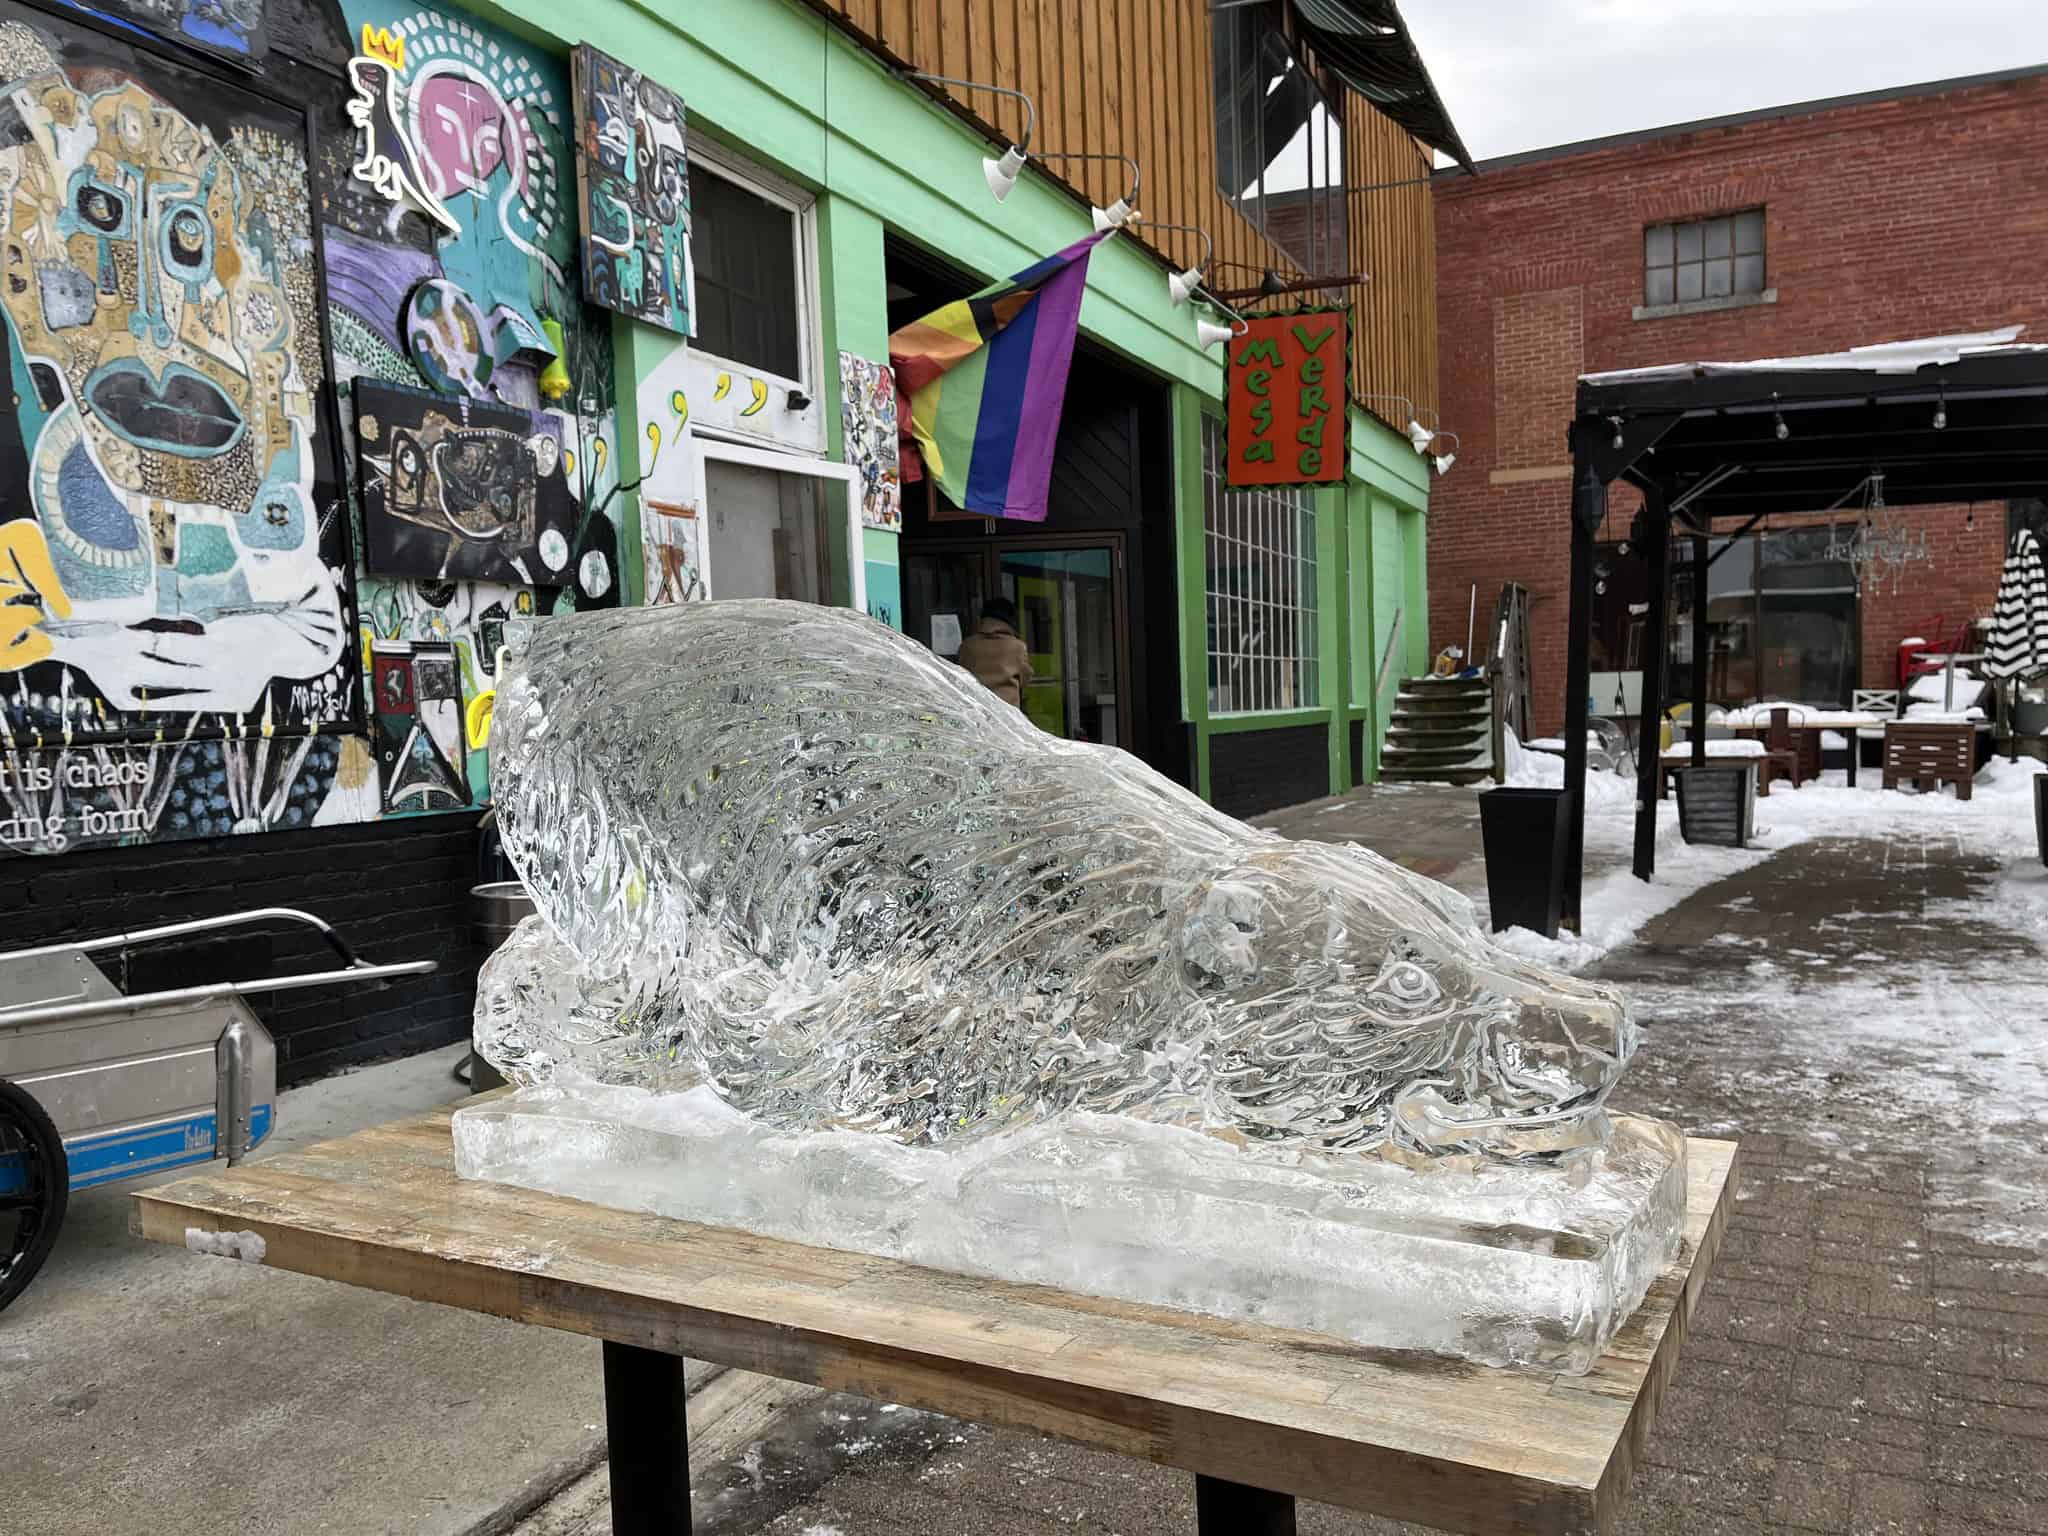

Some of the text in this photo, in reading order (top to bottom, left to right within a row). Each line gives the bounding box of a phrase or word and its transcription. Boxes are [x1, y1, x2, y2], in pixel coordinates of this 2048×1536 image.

[22, 759, 53, 792] is
[66, 755, 149, 788] chaos
[78, 804, 150, 836] form
